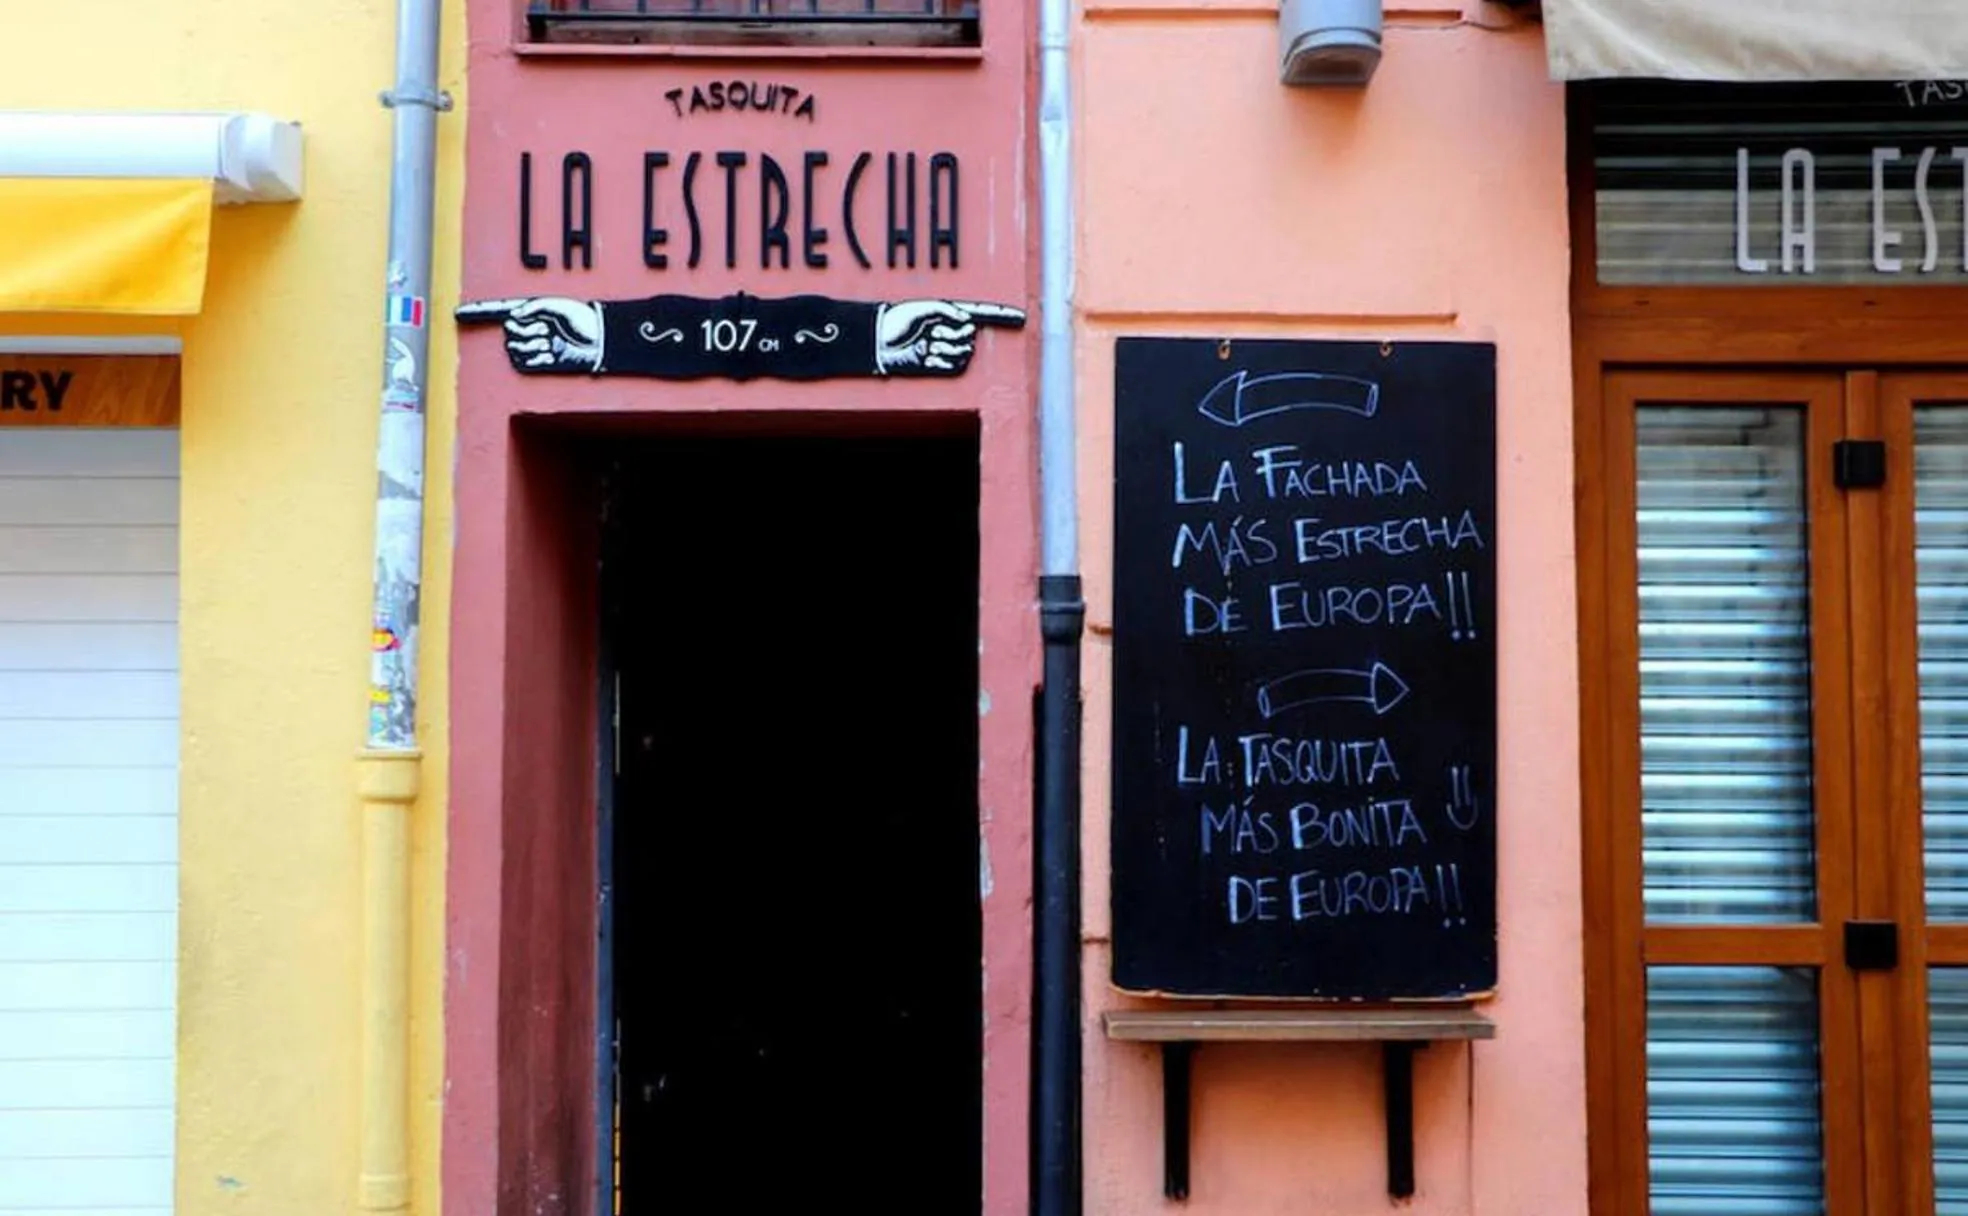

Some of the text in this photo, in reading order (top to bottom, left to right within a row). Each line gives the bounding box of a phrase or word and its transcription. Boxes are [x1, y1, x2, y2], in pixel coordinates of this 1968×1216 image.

[664, 80, 815, 123] TASQUITA
[1894, 80, 1968, 108] TAS
[520, 151, 960, 270] LA ESTRECHA
[1736, 147, 1815, 272] LA
[700, 319, 758, 352] 107
[1, 370, 75, 412] RY
[1174, 441, 1428, 503] LA FACHADA
[1171, 510, 1485, 576] MÁS ESTRECHA
[1183, 586, 1249, 637] DE
[1177, 724, 1400, 788] LA TASQUITA
[1201, 795, 1280, 854] MÁS
[1227, 875, 1280, 924] DE
